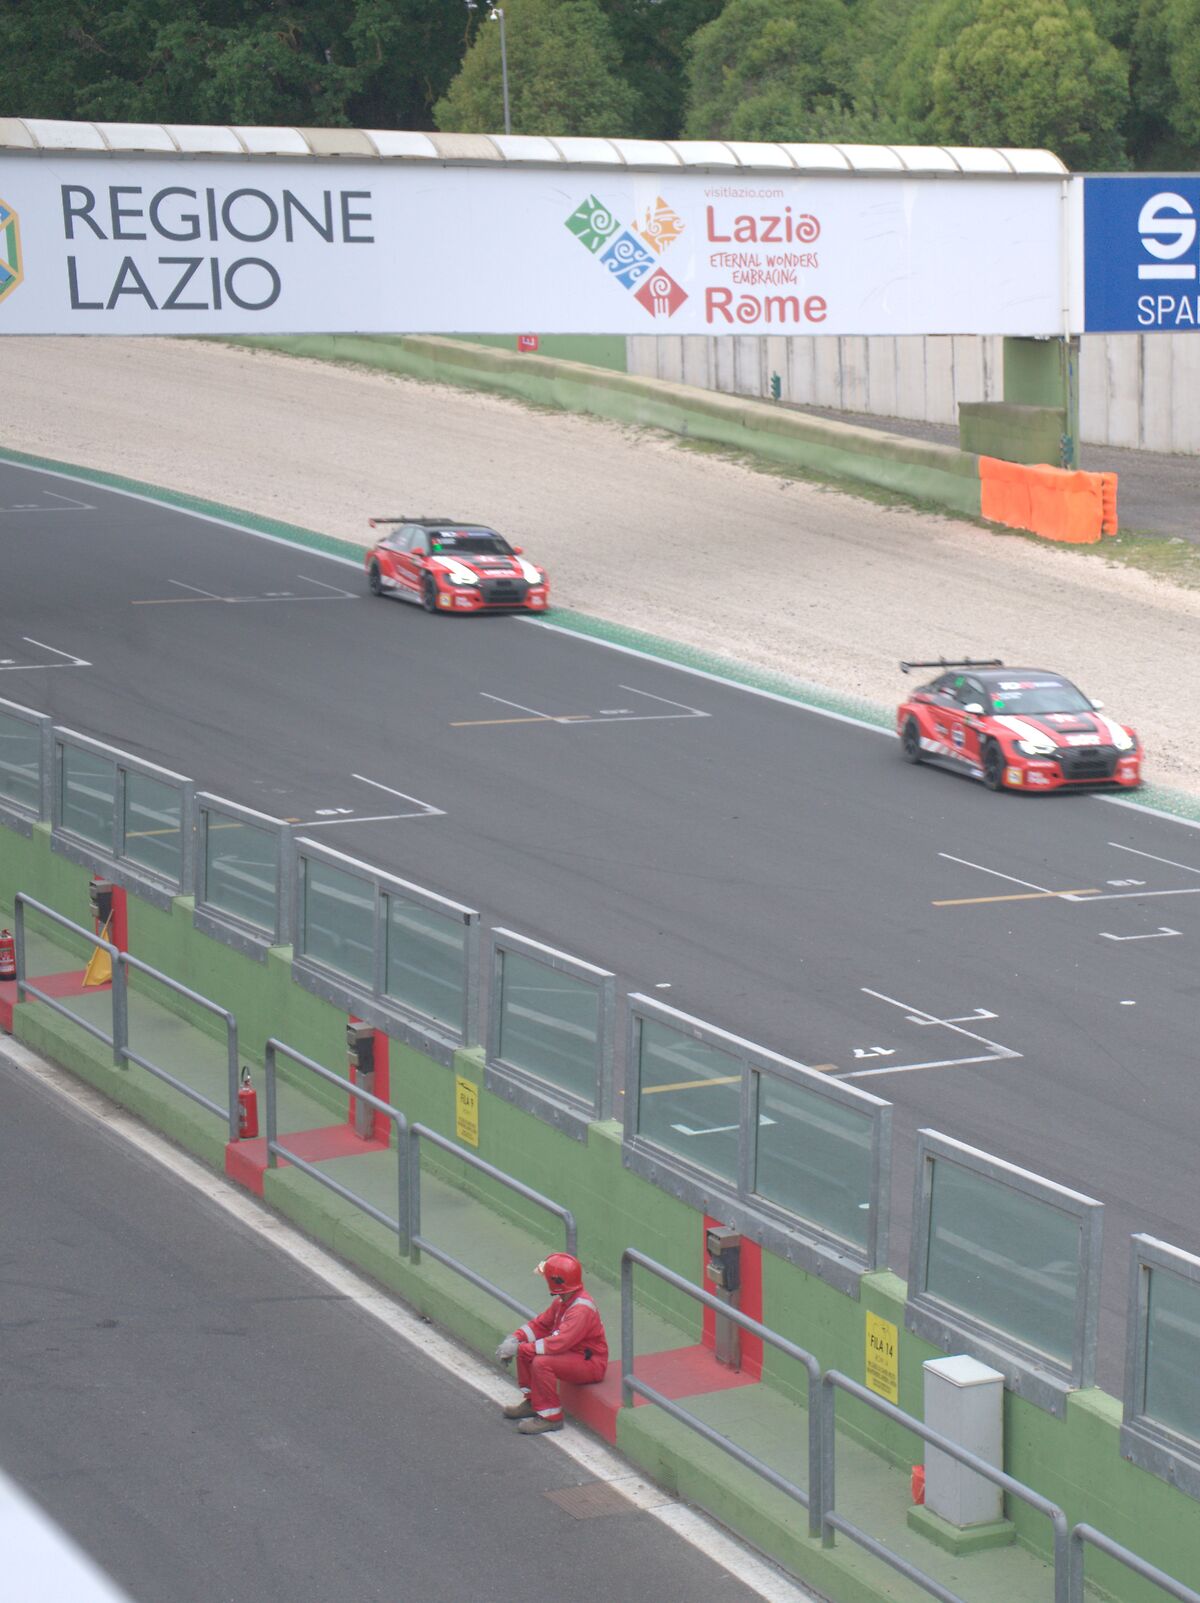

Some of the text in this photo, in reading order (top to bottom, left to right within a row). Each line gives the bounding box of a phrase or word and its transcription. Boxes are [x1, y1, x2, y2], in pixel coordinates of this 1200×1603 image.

[704, 187, 784, 199] visitlazio.com
[61, 185, 375, 243] REGIONE
[706, 205, 821, 244] Lazio
[709, 252, 819, 268] ETERNAL WONDERS
[67, 256, 282, 310] LAZIO
[731, 268, 798, 286] EMBRACING
[705, 287, 827, 324] Rome
[870, 1334, 893, 1358] FILA 14
